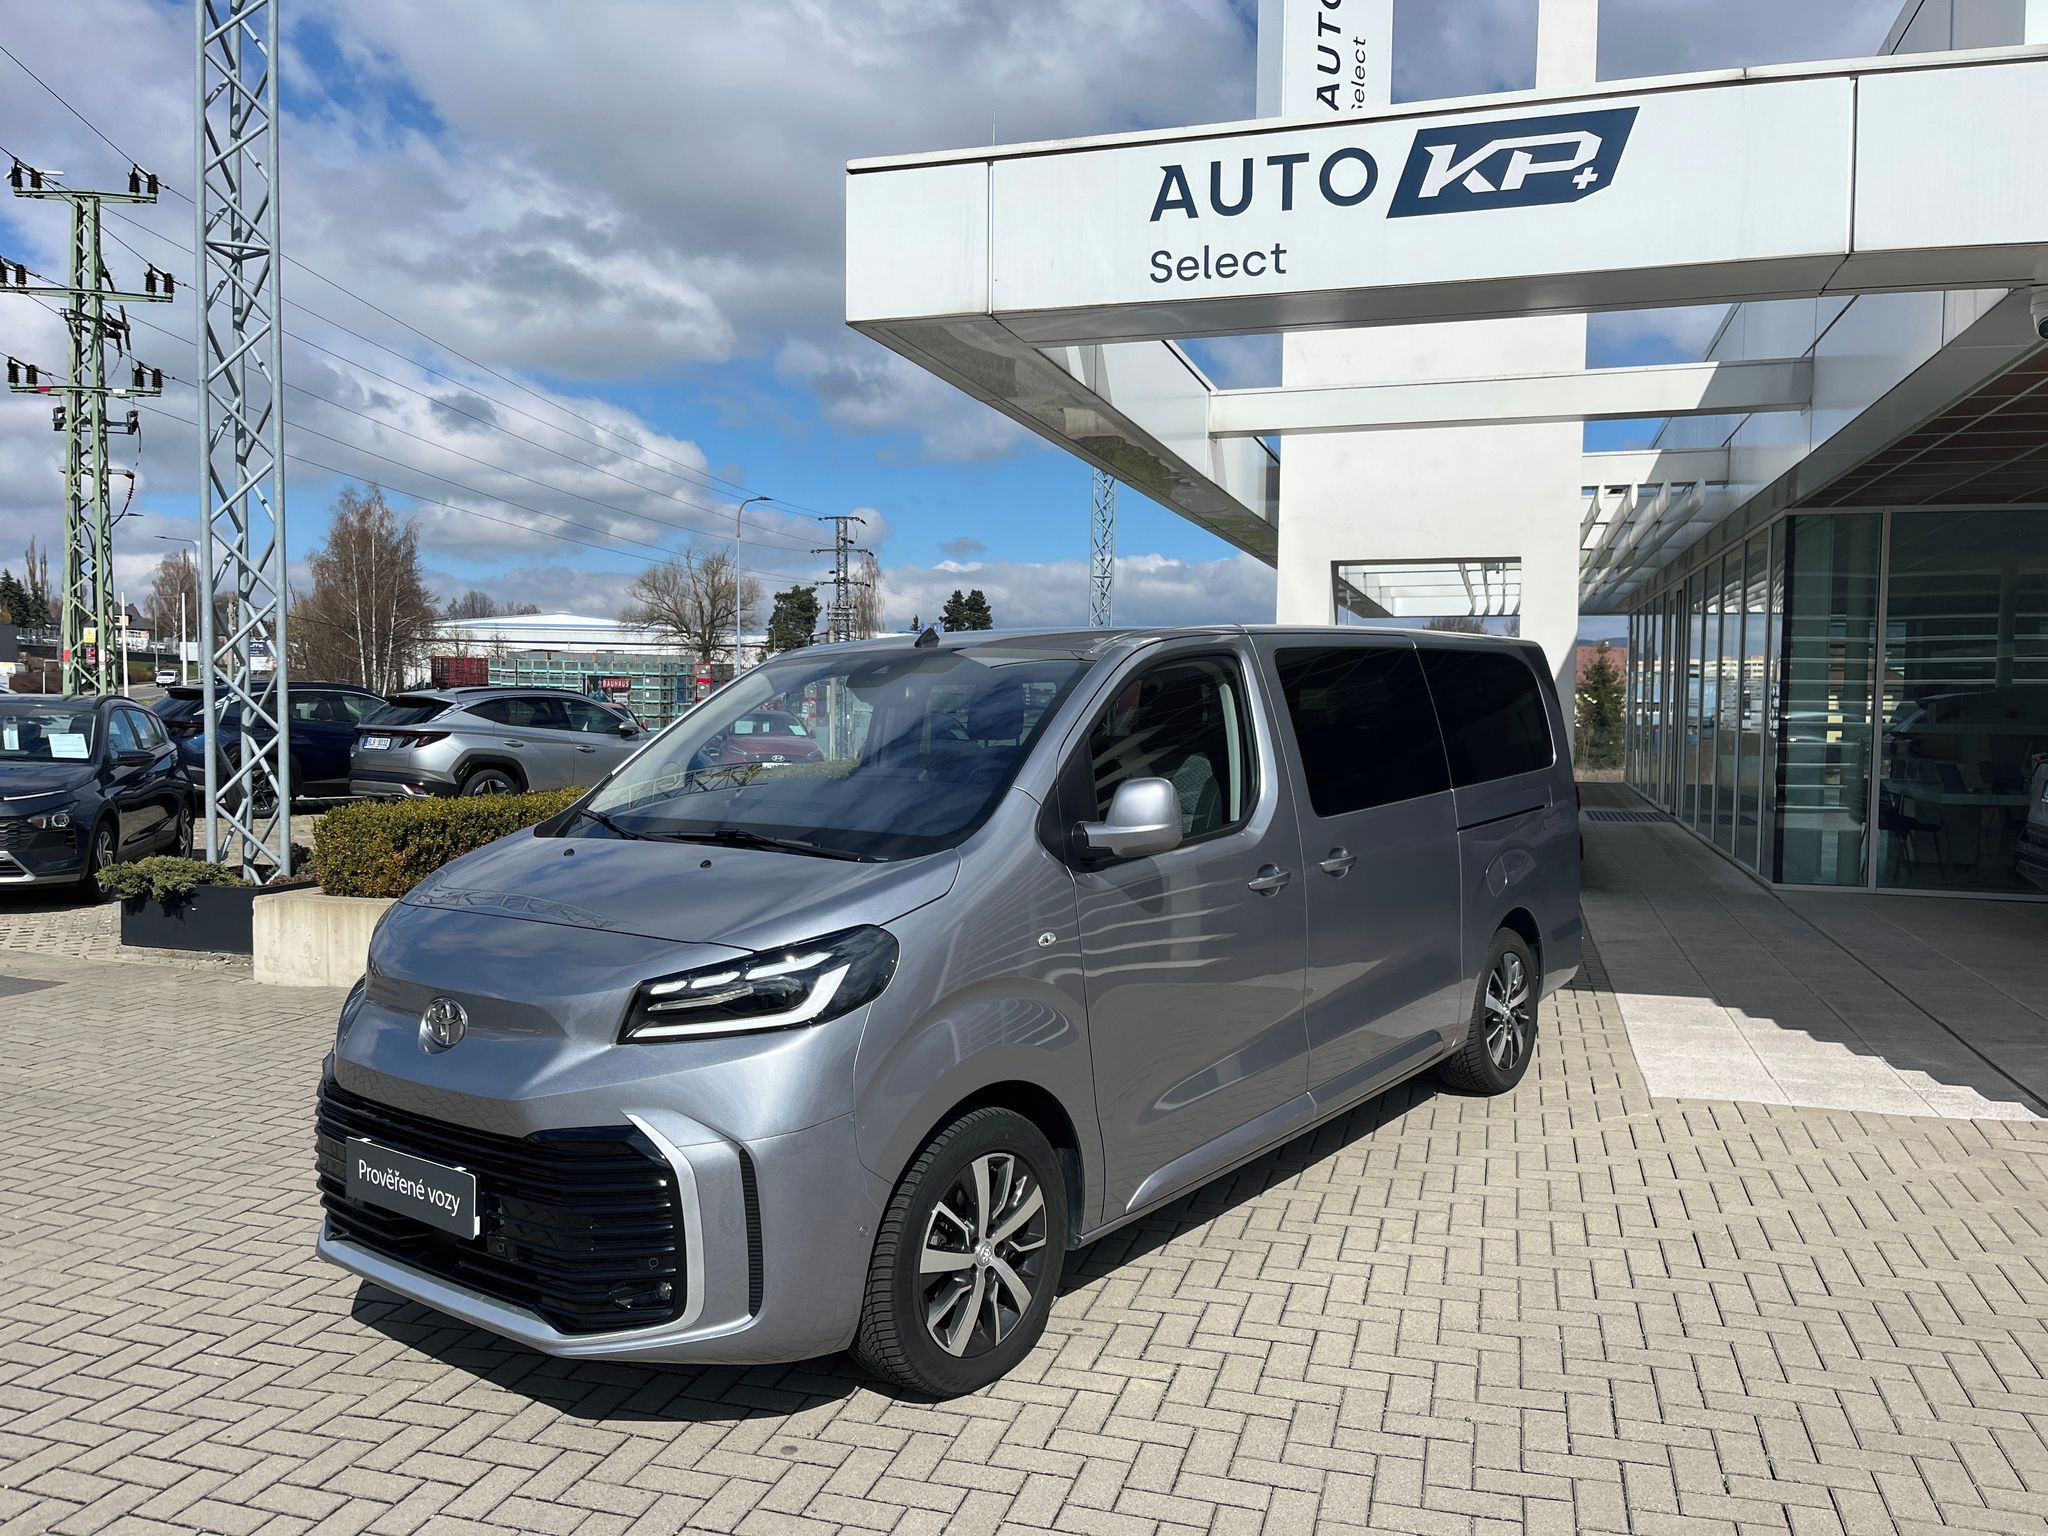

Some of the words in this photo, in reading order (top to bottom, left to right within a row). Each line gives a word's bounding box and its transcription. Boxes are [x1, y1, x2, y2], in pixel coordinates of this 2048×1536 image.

[1150, 147, 1378, 222] AUTO
[1150, 243, 1287, 284] Select
[602, 680, 629, 688] BAUHAUS
[358, 1159, 425, 1200] Prověřené
[428, 1187, 461, 1217] vozy
